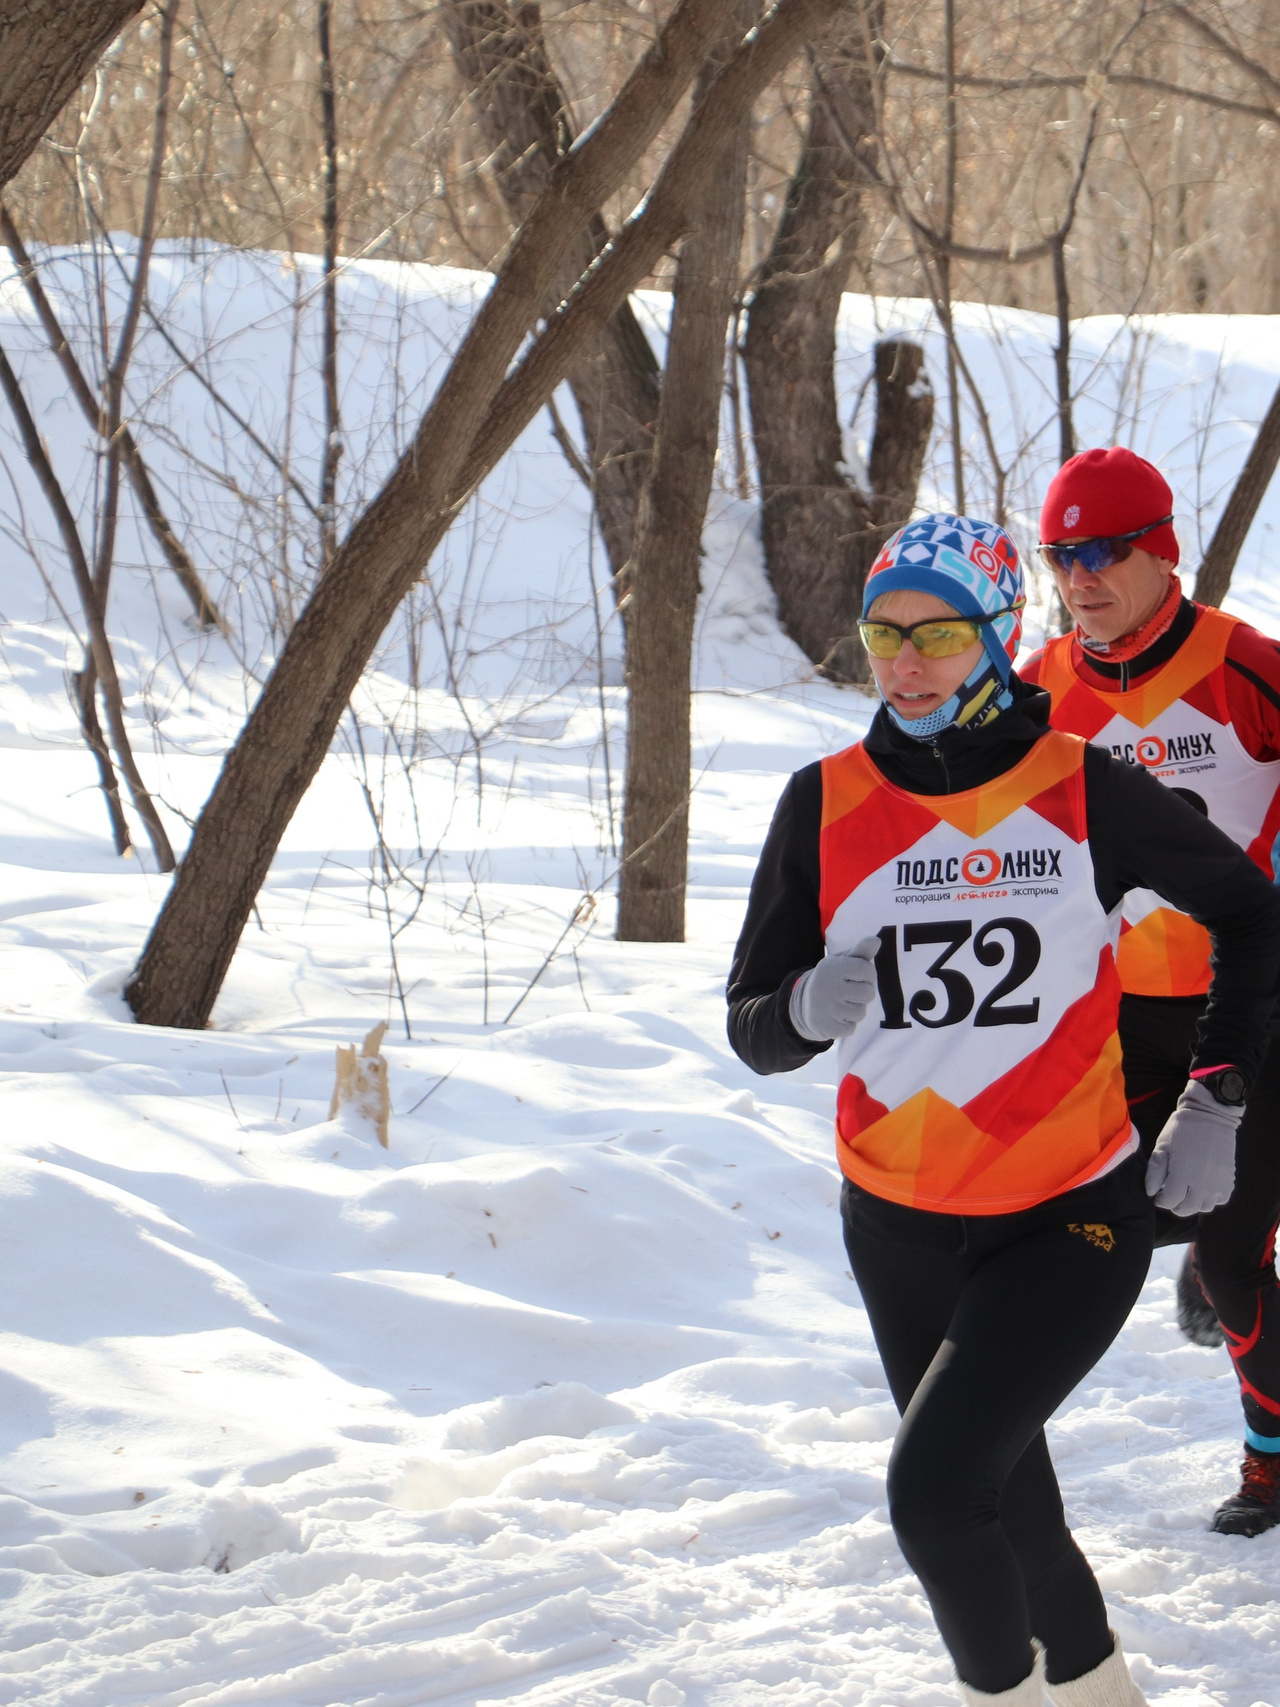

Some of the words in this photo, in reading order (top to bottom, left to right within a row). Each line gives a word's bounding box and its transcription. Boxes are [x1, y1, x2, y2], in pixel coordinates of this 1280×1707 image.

[1178, 762, 1217, 775] экстрима
[896, 848, 1062, 887] ПОДСОЛНУХ
[895, 892, 951, 905] корпорация
[953, 889, 1008, 902] летнего
[1011, 886, 1059, 898] экстрима
[874, 917, 1042, 1030] 132
